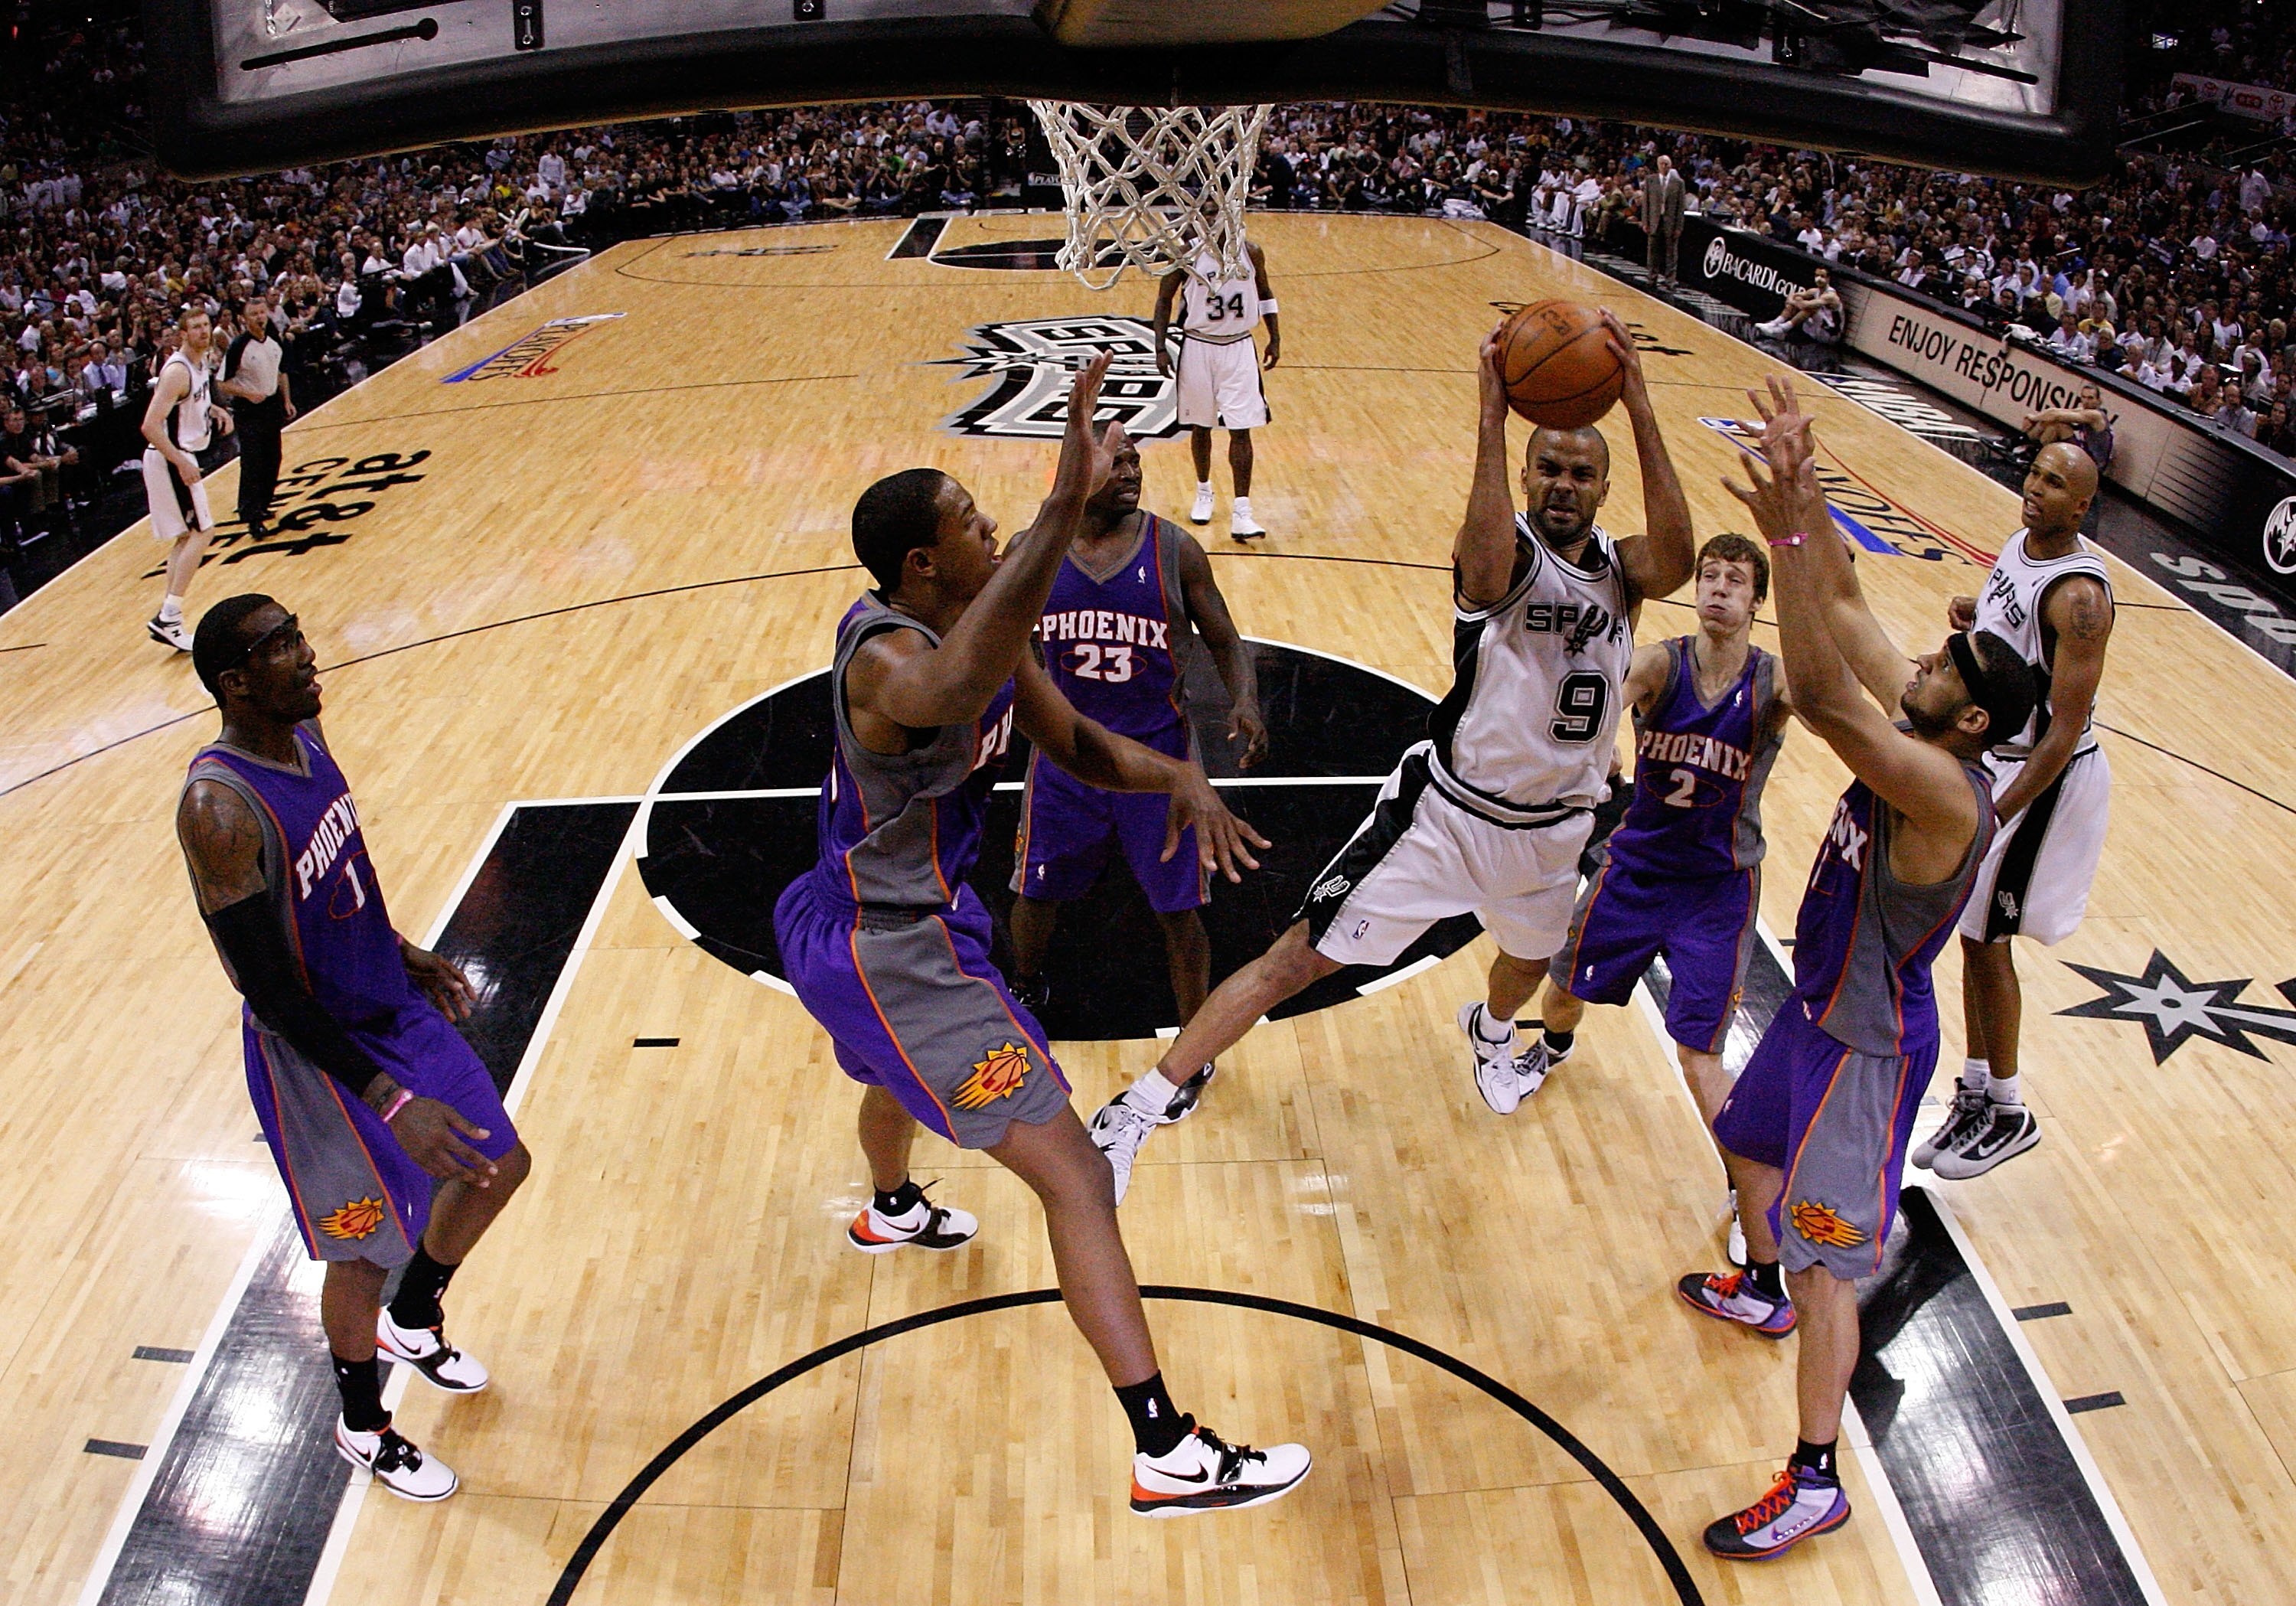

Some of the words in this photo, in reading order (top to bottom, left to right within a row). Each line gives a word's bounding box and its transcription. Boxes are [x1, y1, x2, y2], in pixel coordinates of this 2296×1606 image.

[1722, 253, 1778, 291] BACARDI
[1207, 293, 1244, 320] 34
[1888, 315, 1956, 365] ENJOY
[1955, 344, 2118, 425] RESPONSI
[1988, 568, 2027, 630] PURS
[1042, 610, 1168, 650] PHOENIX
[1075, 644, 1133, 683] 23
[1548, 668, 1610, 745] 9
[1639, 730, 1752, 782] PHOENIX
[1664, 768, 1696, 808] 2
[345, 860, 366, 909] 1
